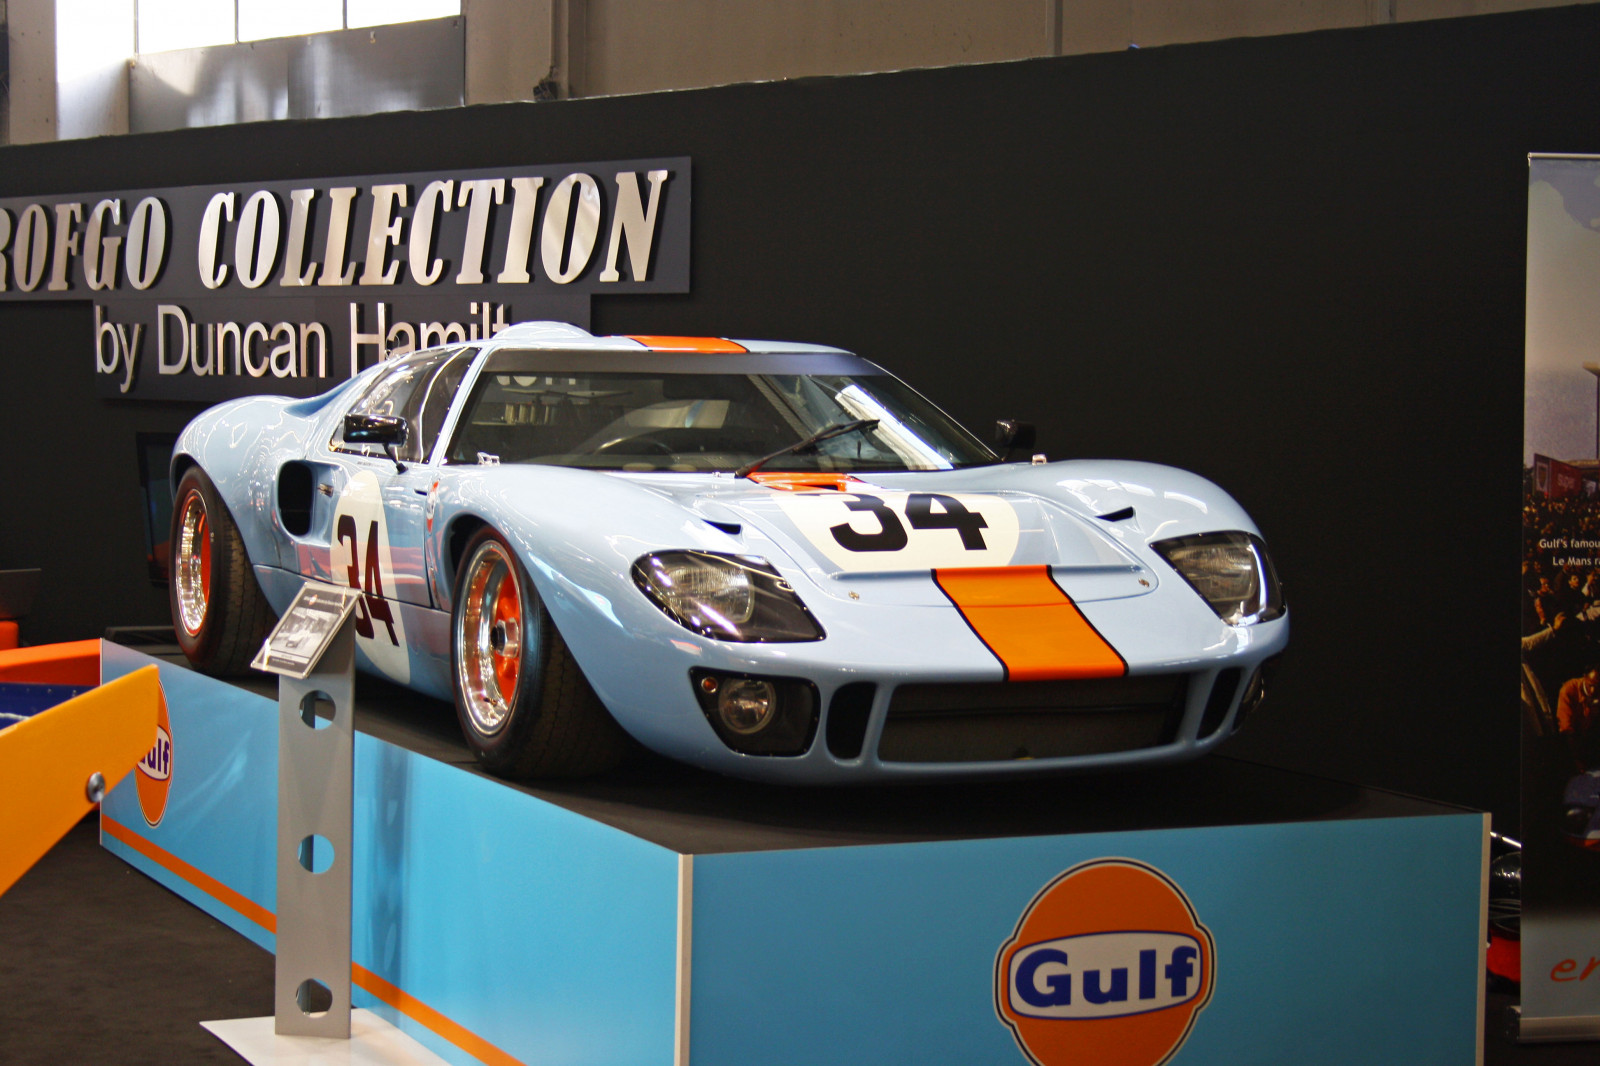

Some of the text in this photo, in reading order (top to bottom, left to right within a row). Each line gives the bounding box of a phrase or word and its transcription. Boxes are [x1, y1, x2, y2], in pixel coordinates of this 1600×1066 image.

[198, 169, 668, 290] COLLECTION
[95, 305, 140, 393] by
[157, 304, 326, 379] Duncan
[829, 493, 989, 553] 34
[1540, 539, 1568, 549] Gulf's
[338, 514, 400, 647] 34
[1552, 556, 1565, 566] Le
[1567, 556, 1592, 566] Mans
[141, 738, 170, 775] ulf
[1015, 946, 1197, 1008] Gulf
